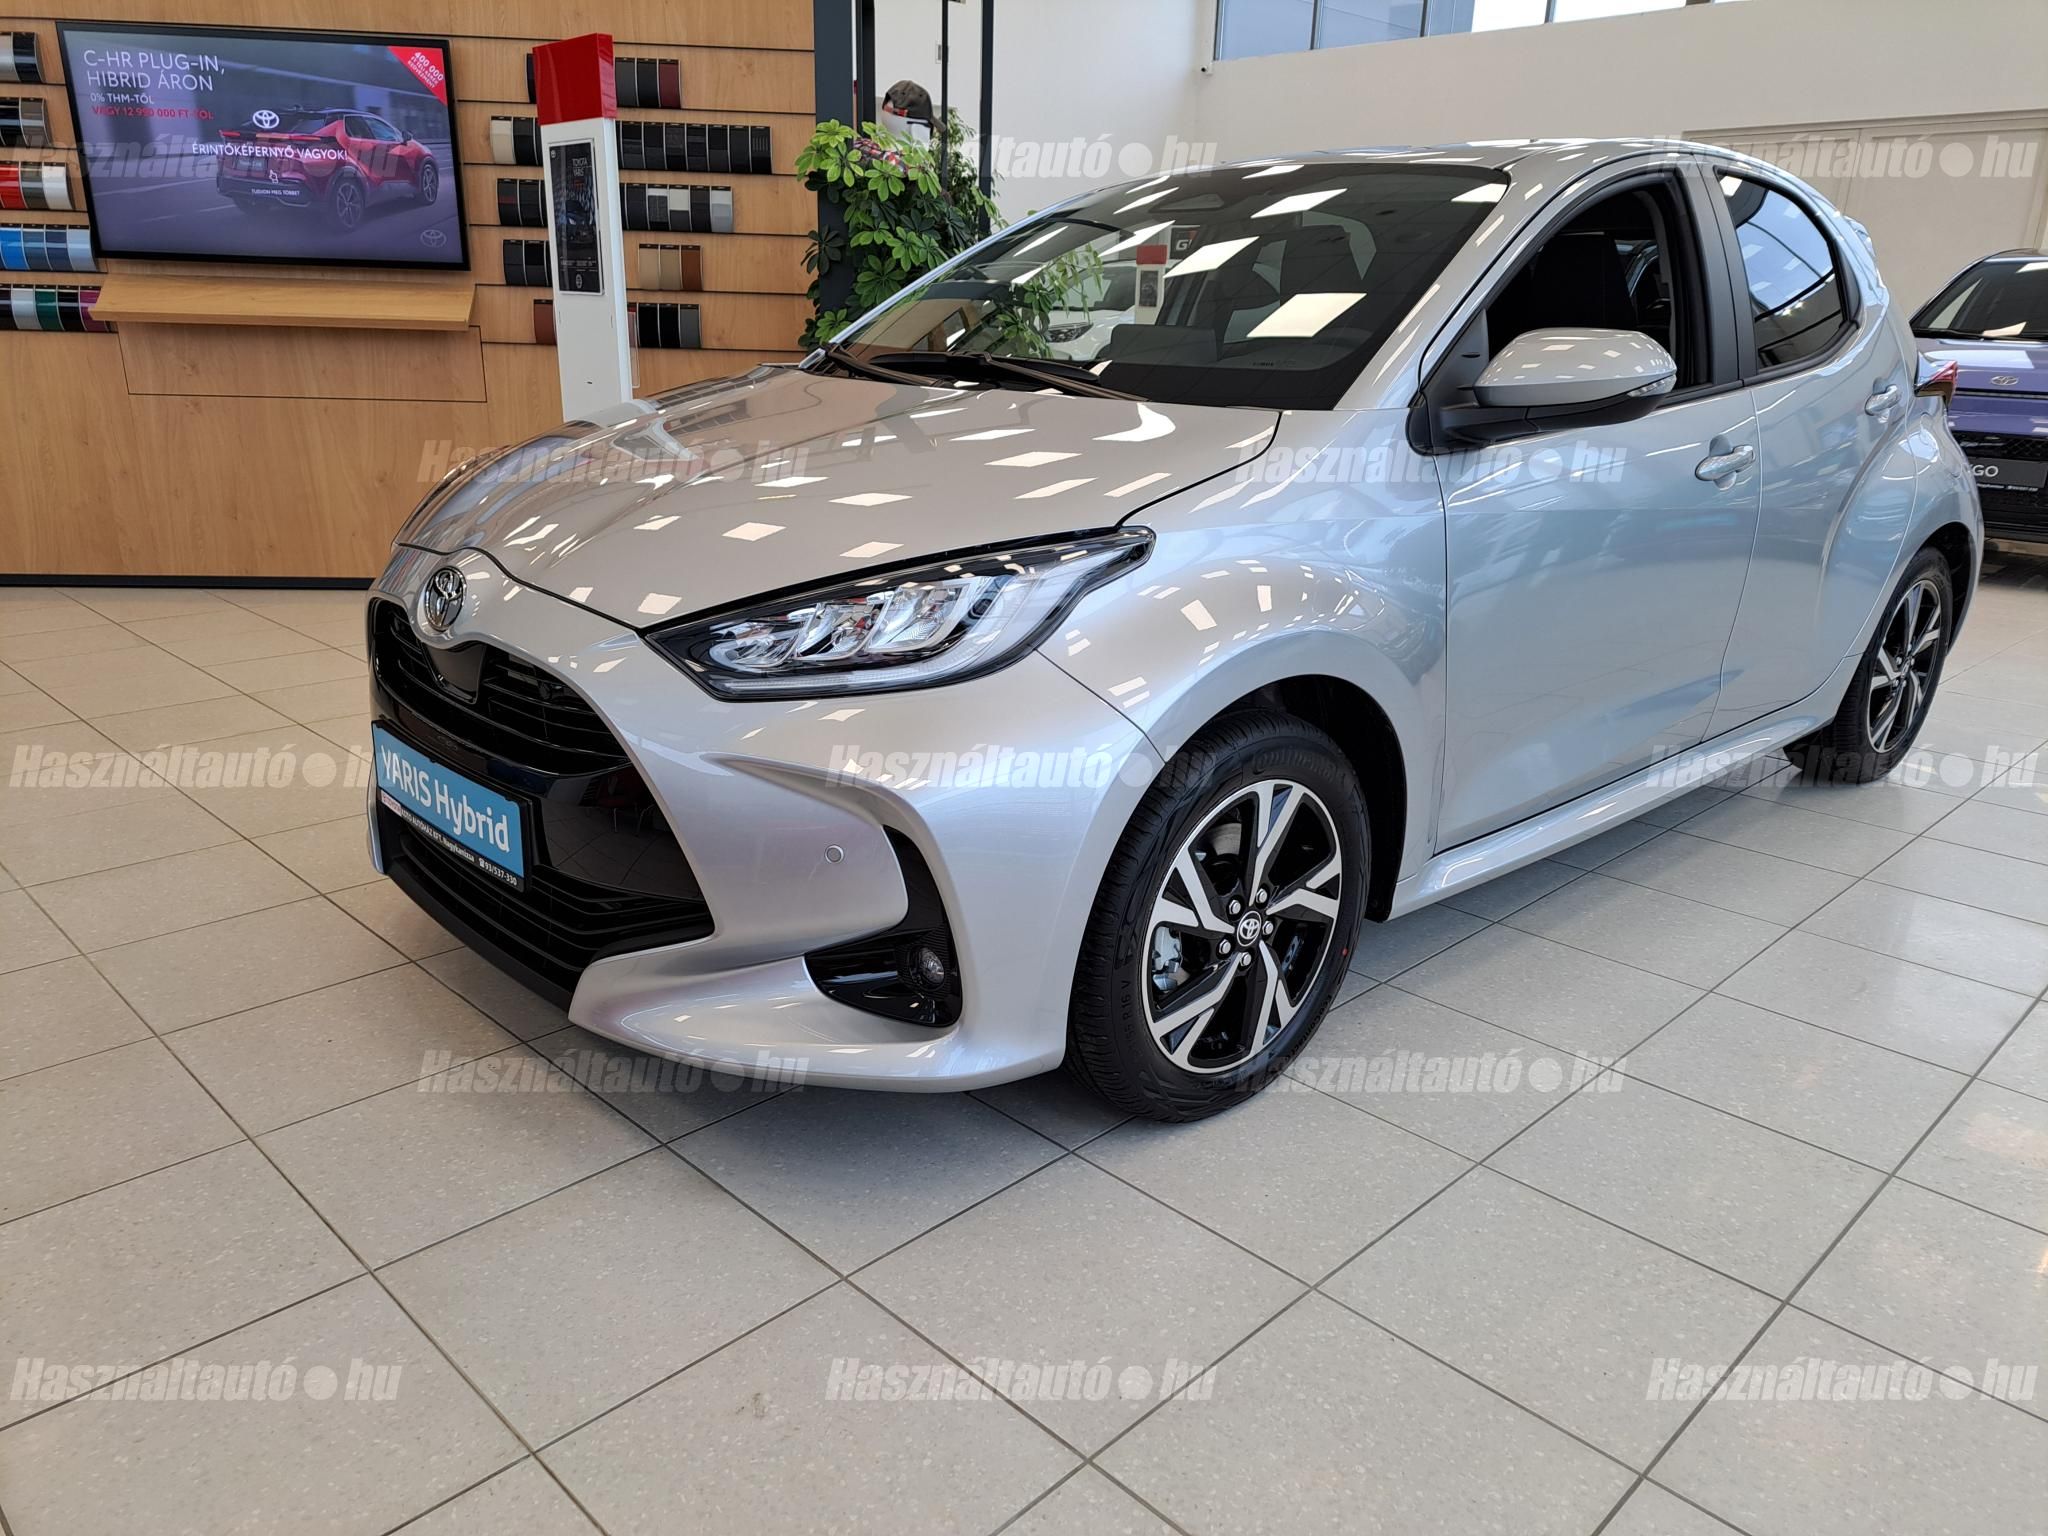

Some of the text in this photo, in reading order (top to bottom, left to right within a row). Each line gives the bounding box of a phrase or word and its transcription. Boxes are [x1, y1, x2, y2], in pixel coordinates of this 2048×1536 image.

[84, 50, 225, 75] C-HR PLUG-IN,
[414, 51, 444, 81] 400 000
[87, 69, 214, 91] HIBRID ÁRON
[90, 93, 106, 103] 0%
[295, 148, 348, 161] VAGYOK!
[381, 744, 511, 853] YARIS Hybrid
